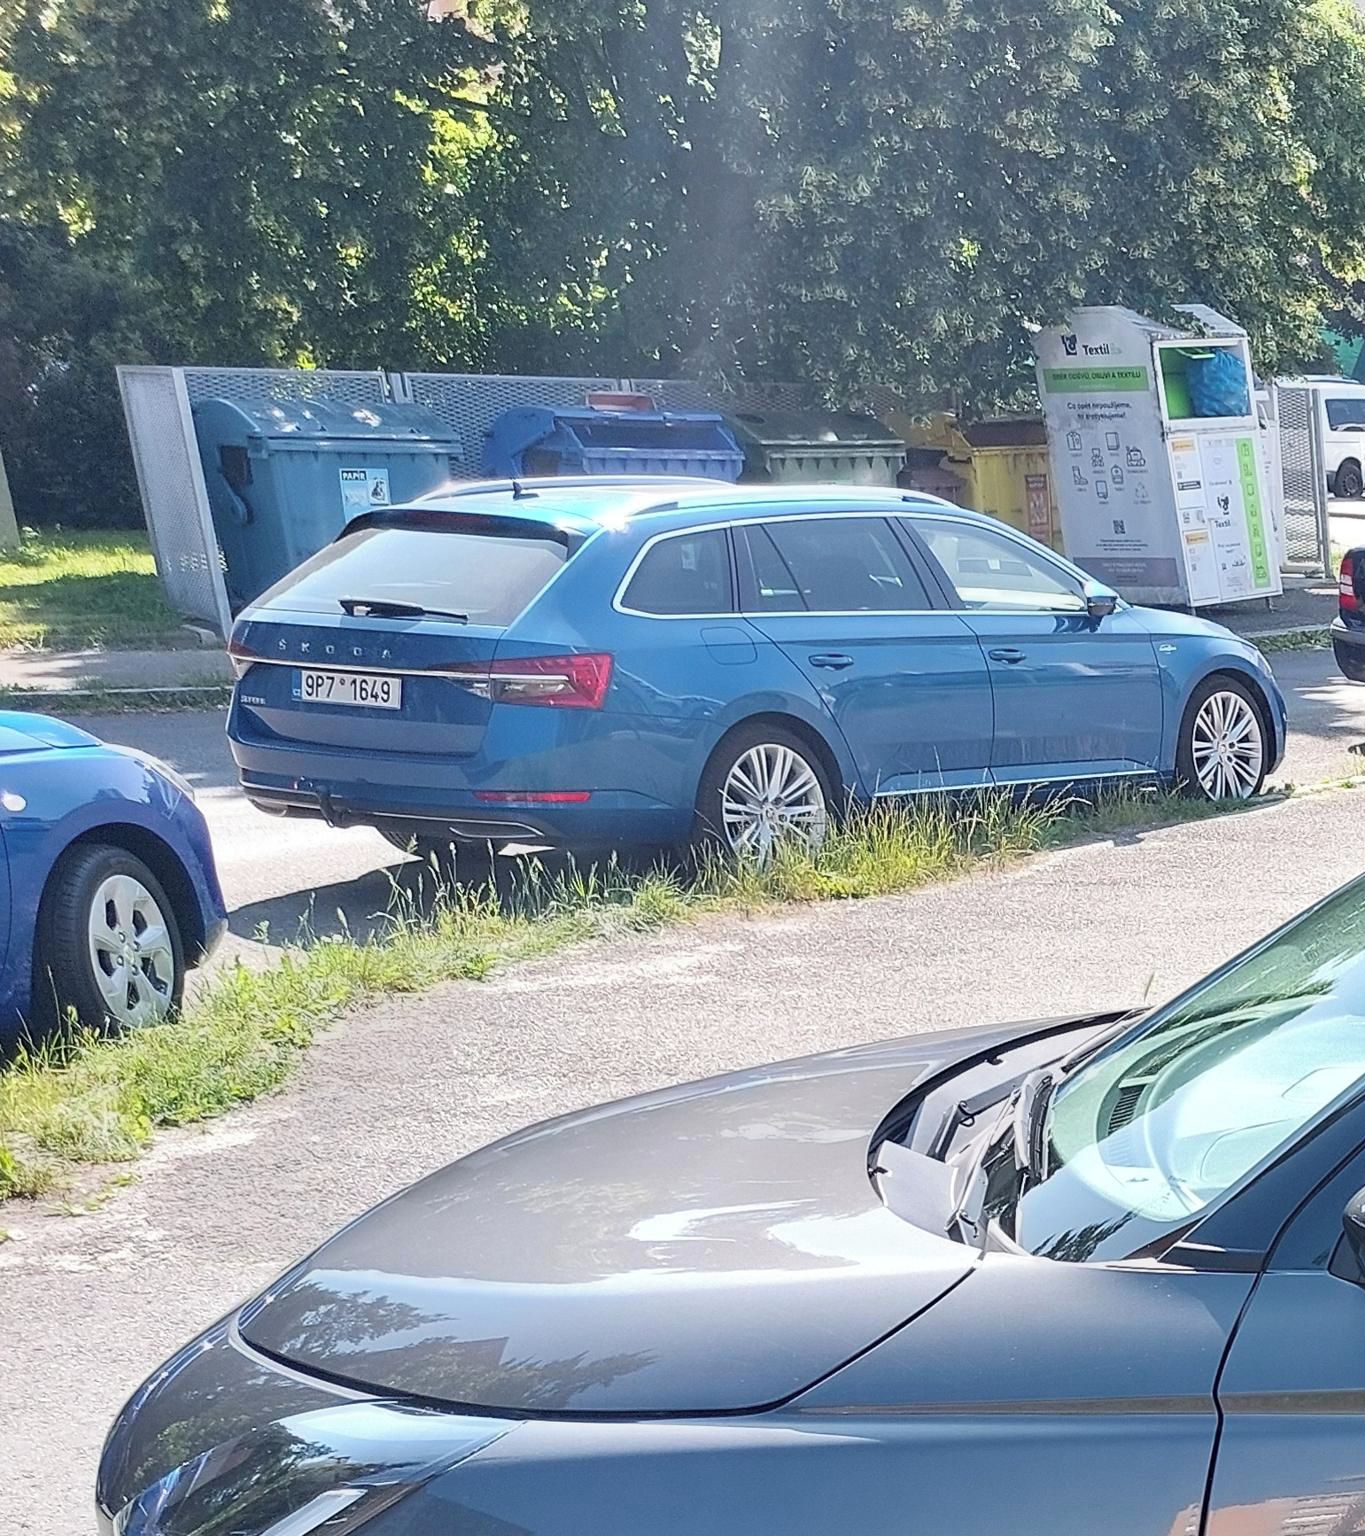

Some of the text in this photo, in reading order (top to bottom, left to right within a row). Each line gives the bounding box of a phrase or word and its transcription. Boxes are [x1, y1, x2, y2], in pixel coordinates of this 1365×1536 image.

[278, 638, 393, 659] ŠKODA
[305, 674, 392, 703] 9P7 1649
